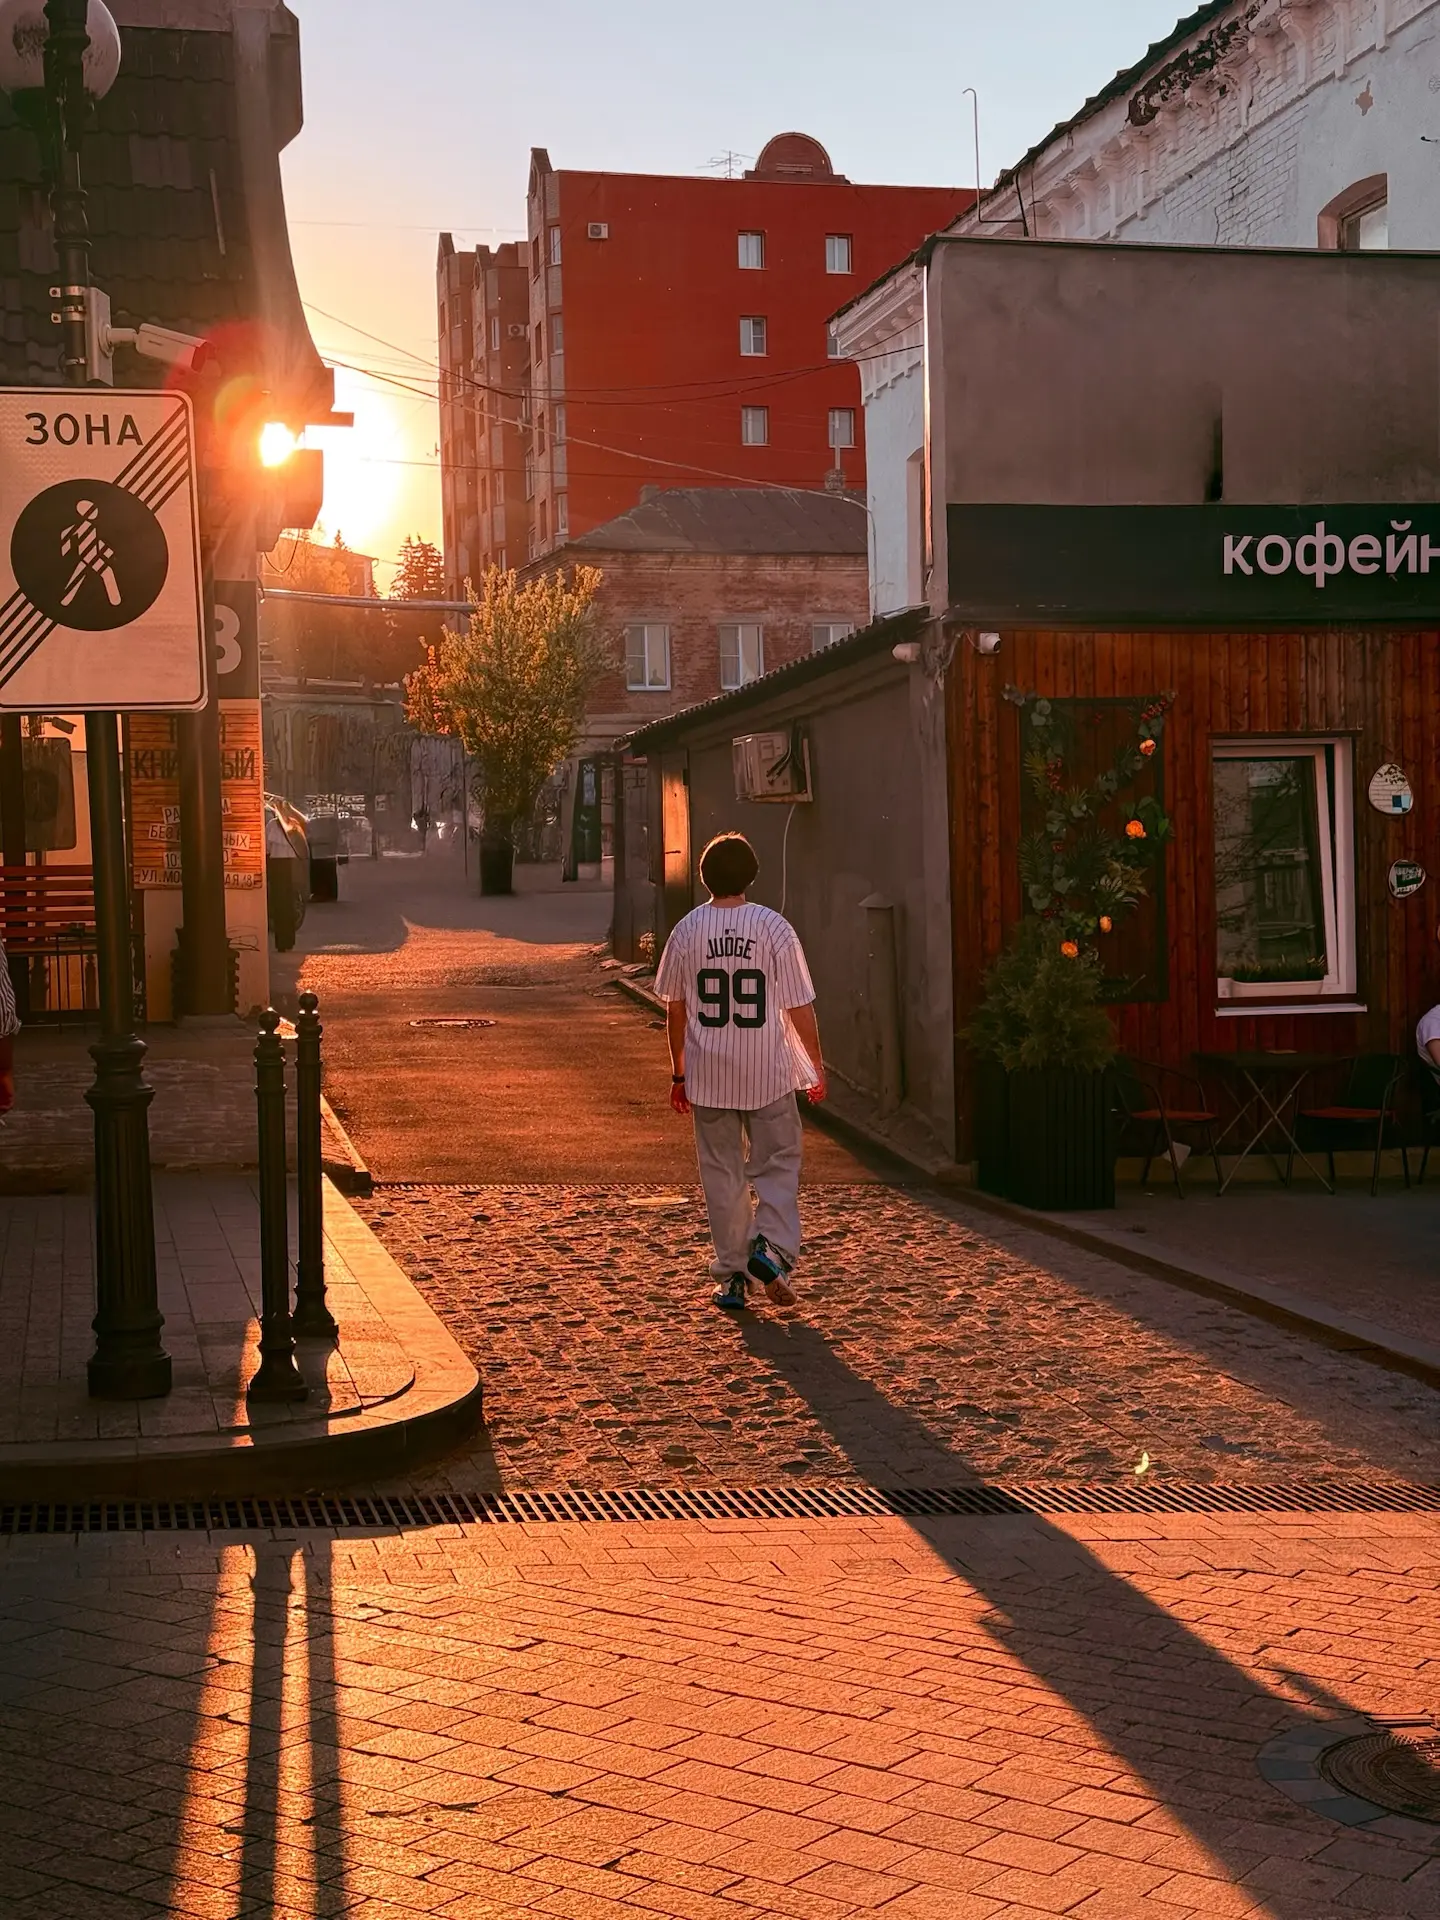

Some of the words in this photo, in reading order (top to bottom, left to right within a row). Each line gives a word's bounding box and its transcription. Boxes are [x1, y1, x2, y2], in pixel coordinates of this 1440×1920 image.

[25, 412, 143, 446] ЗОНА
[706, 936, 756, 960] JUDGE
[697, 968, 766, 1028] 99
